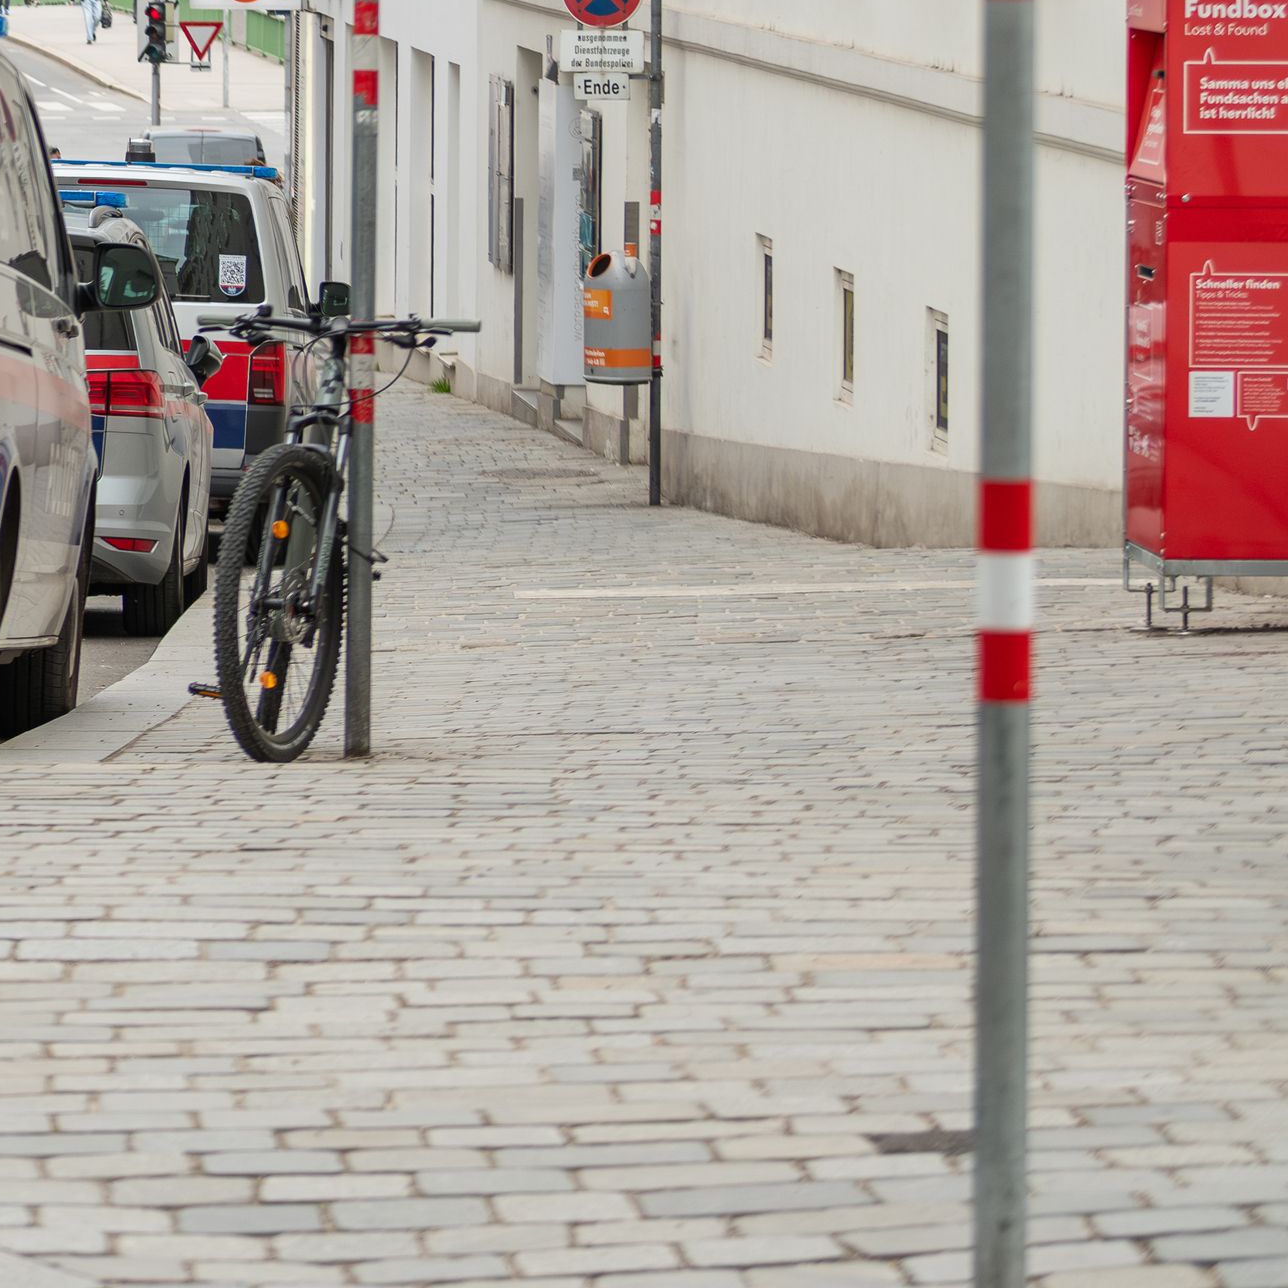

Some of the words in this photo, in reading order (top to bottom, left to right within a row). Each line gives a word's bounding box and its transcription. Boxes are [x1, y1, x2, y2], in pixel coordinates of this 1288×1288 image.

[1184, 22, 1212, 36] Lost
[1214, 23, 1225, 36] &
[1228, 23, 1268, 36] Found
[574, 45, 630, 57] Dienstfahrzeuge
[585, 58, 634, 69] Bundespolizei
[584, 79, 620, 95] Ende
[1200, 77, 1250, 90] Samma
[1251, 79, 1276, 90] uns
[1200, 92, 1279, 105] Fundsachen
[1199, 106, 1217, 119] ist
[1218, 106, 1276, 120] herrlich!
[1195, 278, 1244, 290] Schneller
[1246, 278, 1281, 290] finden
